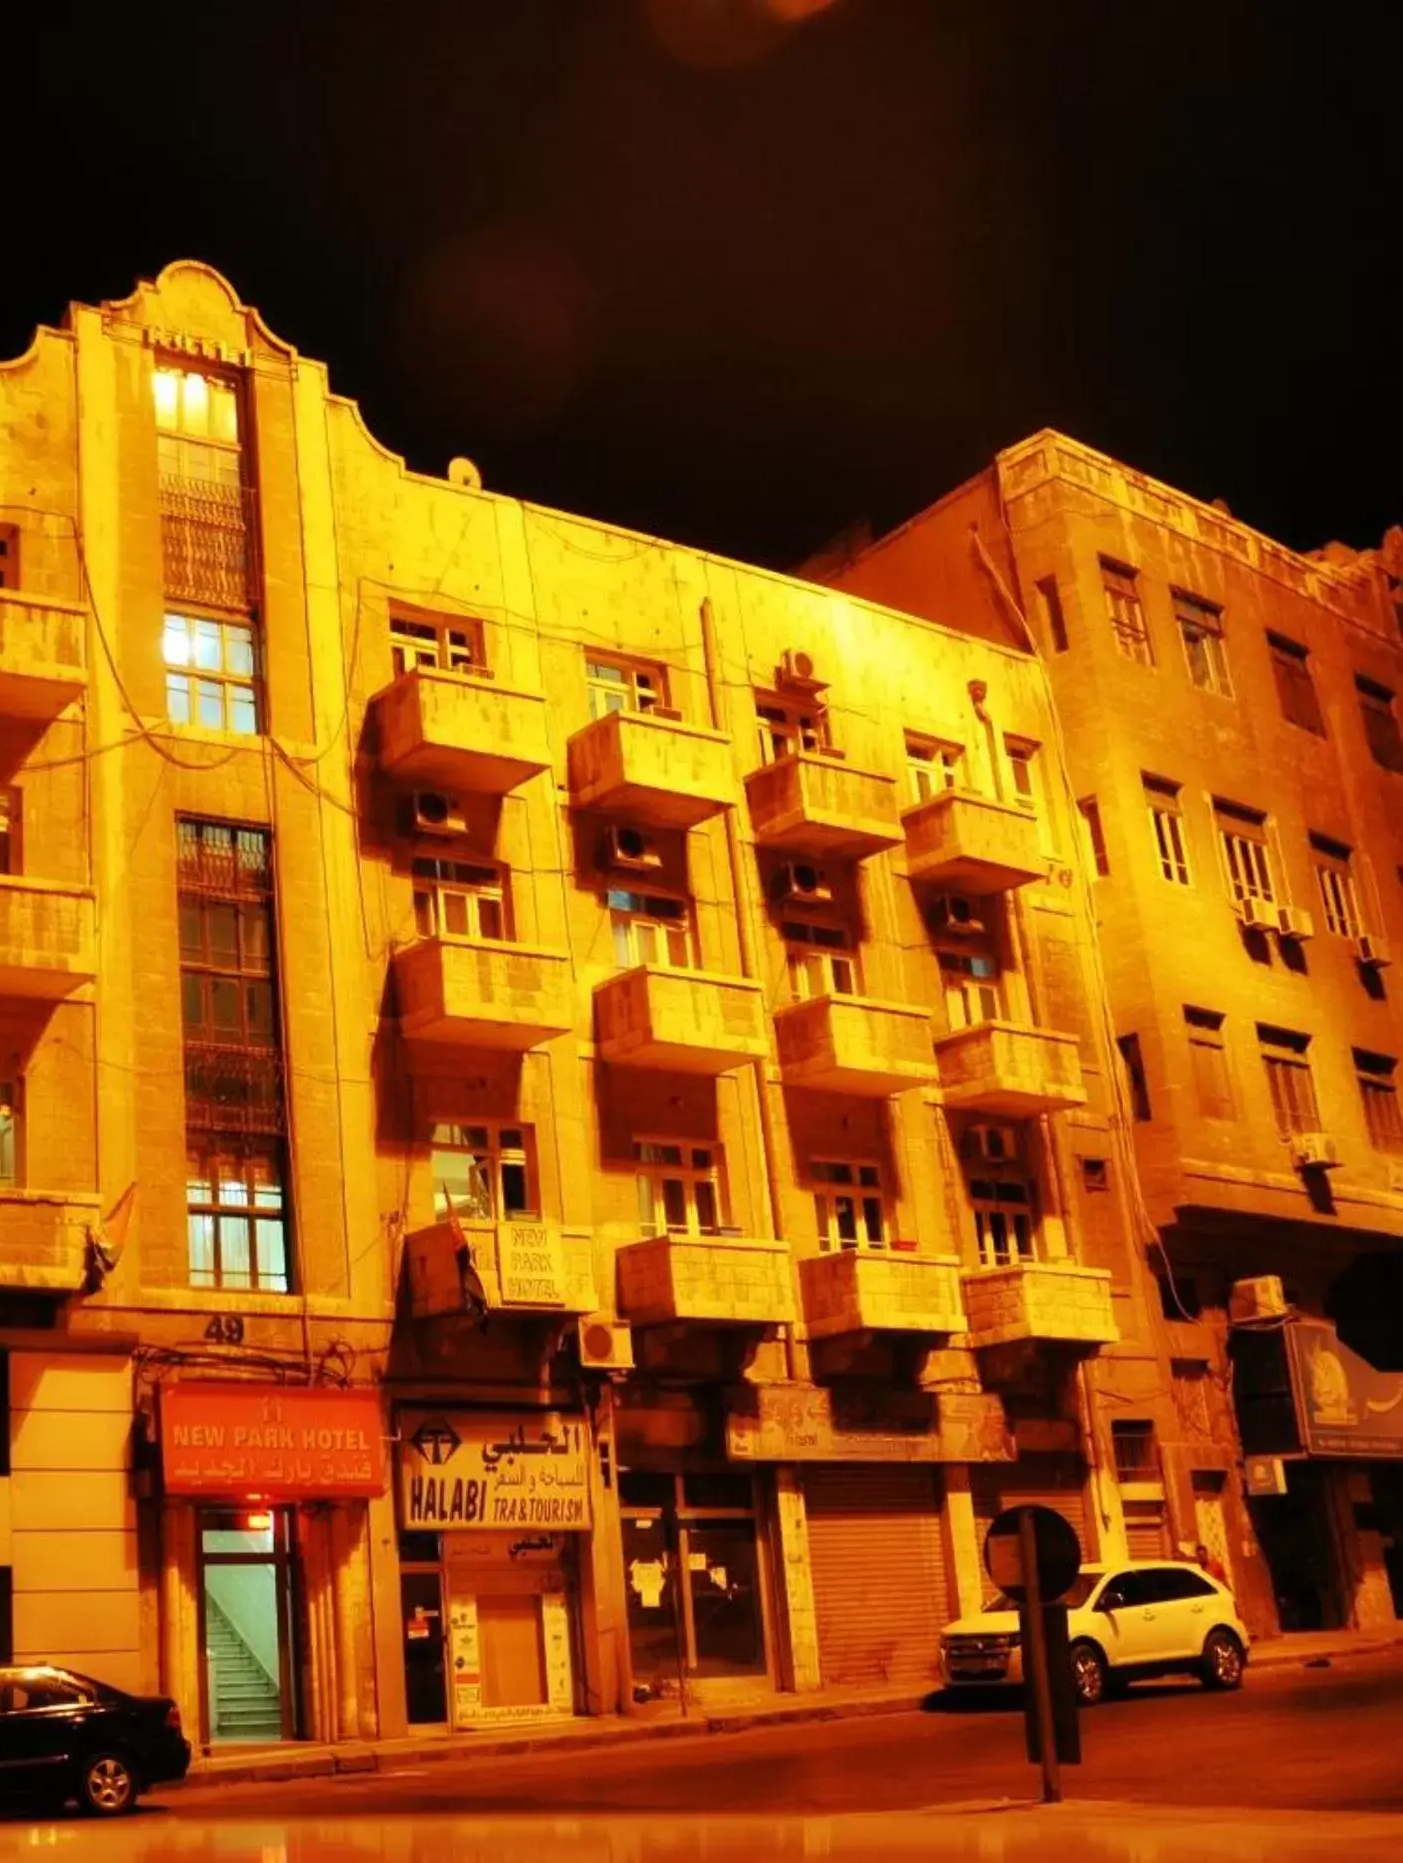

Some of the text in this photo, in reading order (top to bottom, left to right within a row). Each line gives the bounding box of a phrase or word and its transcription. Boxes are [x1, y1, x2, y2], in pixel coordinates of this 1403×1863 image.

[510, 1251, 552, 1273] PARK
[506, 1277, 560, 1299] HOTEL
[204, 1315, 244, 1344] 49
[174, 1426, 371, 1450] NEW PARK HOTEL
[482, 1424, 581, 1473] الحلبي
[174, 1454, 372, 1486] فندق بارك الجديد
[410, 1476, 488, 1522] HALABI
